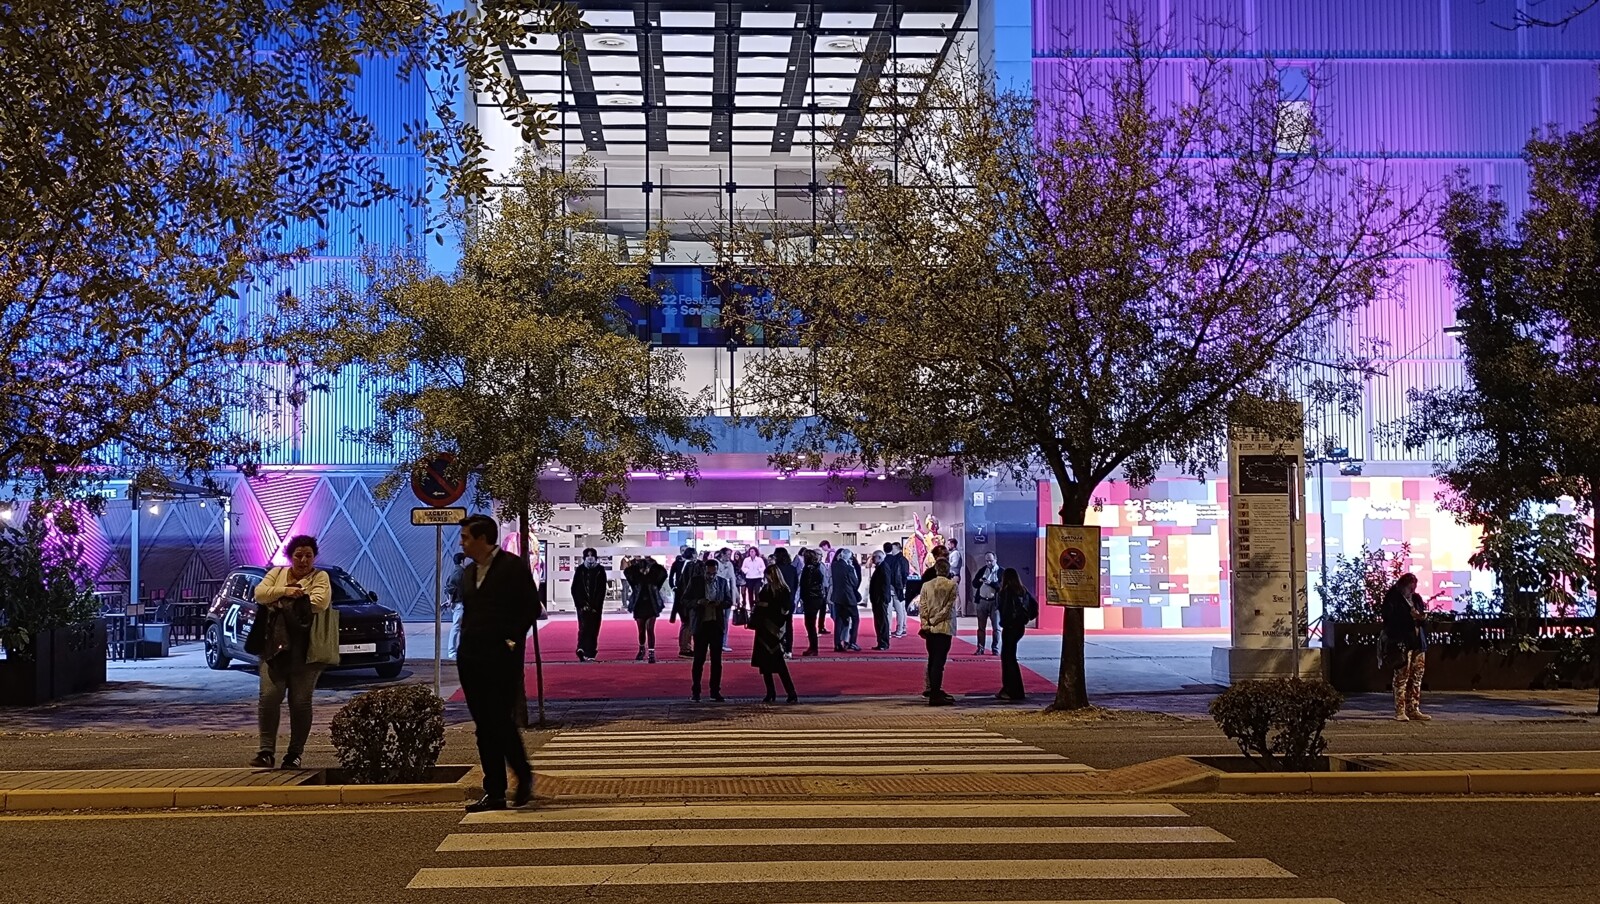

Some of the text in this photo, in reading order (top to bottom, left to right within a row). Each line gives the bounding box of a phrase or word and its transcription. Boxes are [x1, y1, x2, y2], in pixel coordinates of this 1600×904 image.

[661, 294, 721, 305] 22 Festival
[662, 305, 678, 315] de
[977, 527, 983, 536] 7
